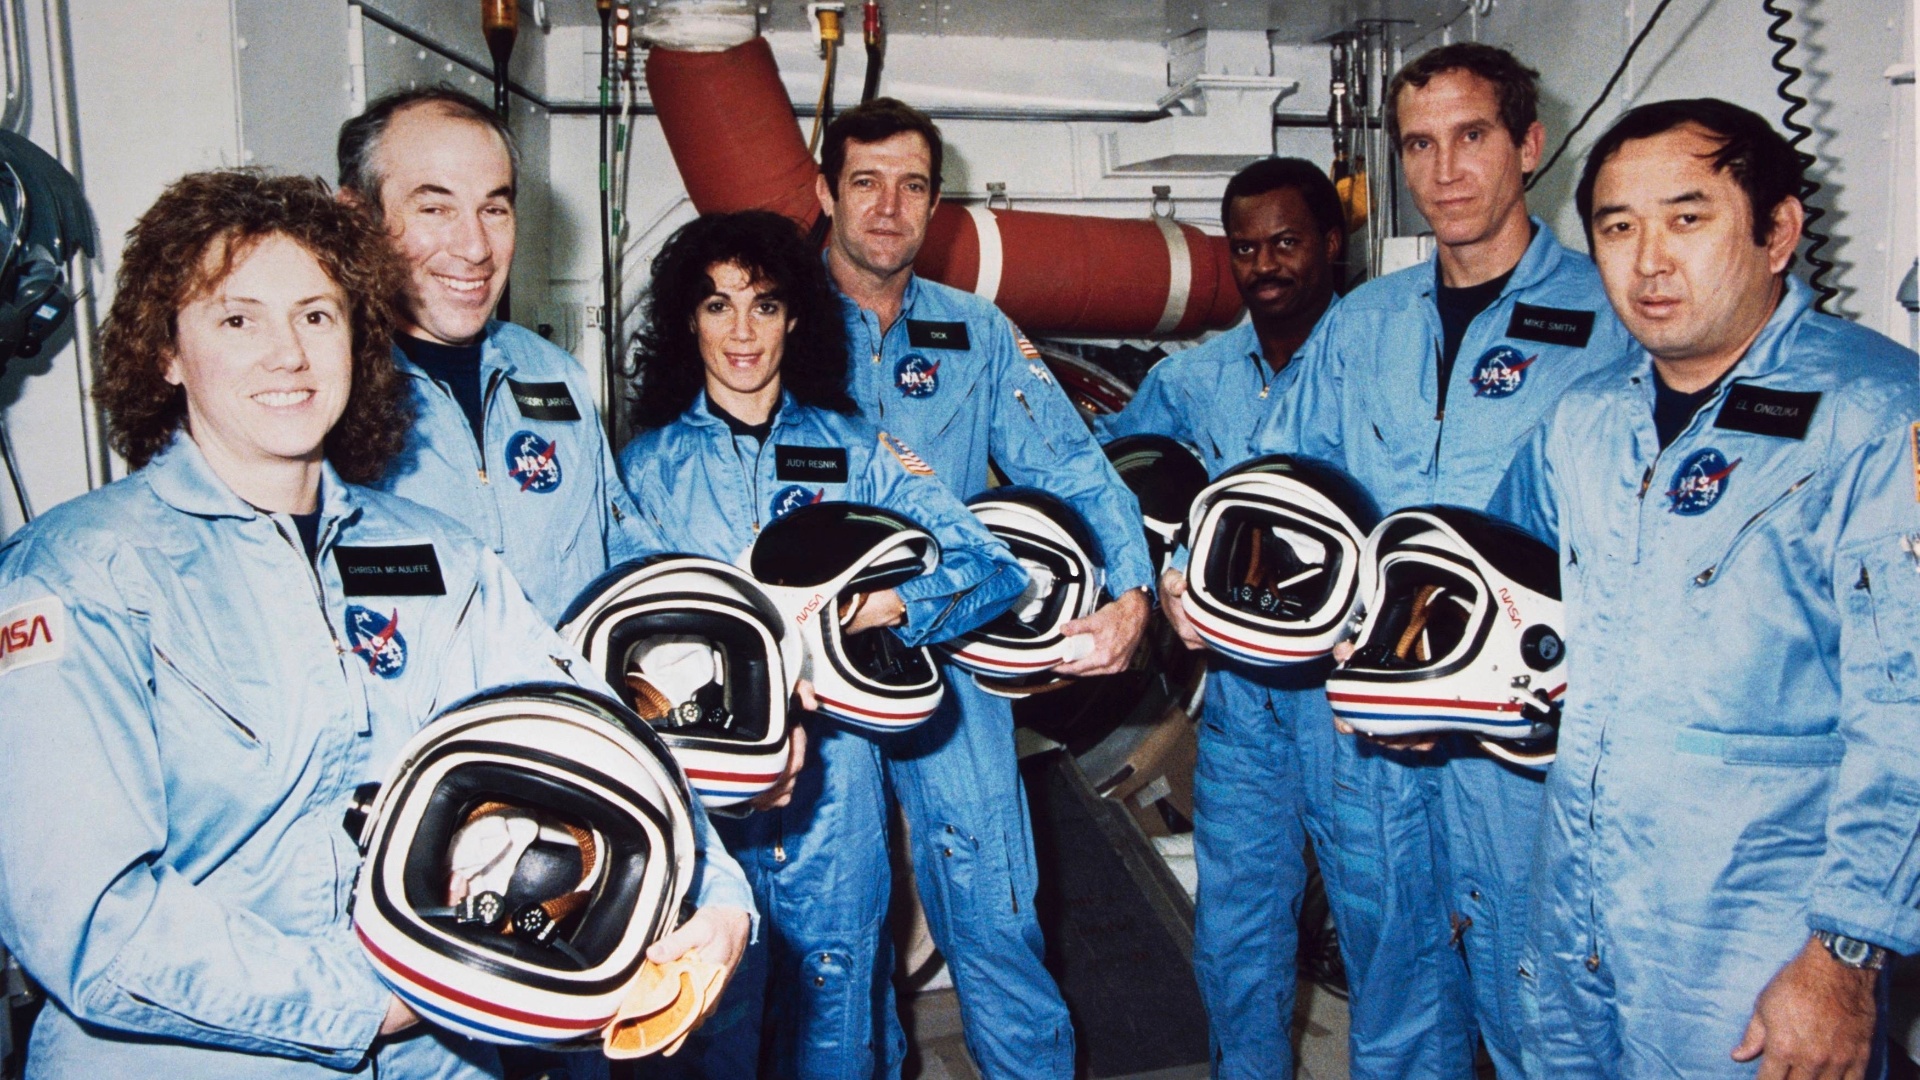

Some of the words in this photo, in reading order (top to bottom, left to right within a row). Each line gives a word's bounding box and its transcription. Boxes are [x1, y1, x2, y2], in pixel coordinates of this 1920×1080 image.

[1523, 318, 1545, 329] MIKE
[1547, 322, 1577, 333] SMITH
[930, 331, 948, 340] DICK
[546, 397, 572, 407] JARVIS
[1754, 403, 1799, 417] ONIZUKA
[786, 458, 805, 467] JUDY
[808, 459, 838, 469] RESNIK
[348, 566, 383, 574] CHRISTA
[796, 593, 824, 625] NASA
[1499, 587, 1522, 629] NASA
[0, 614, 53, 658] ASA
